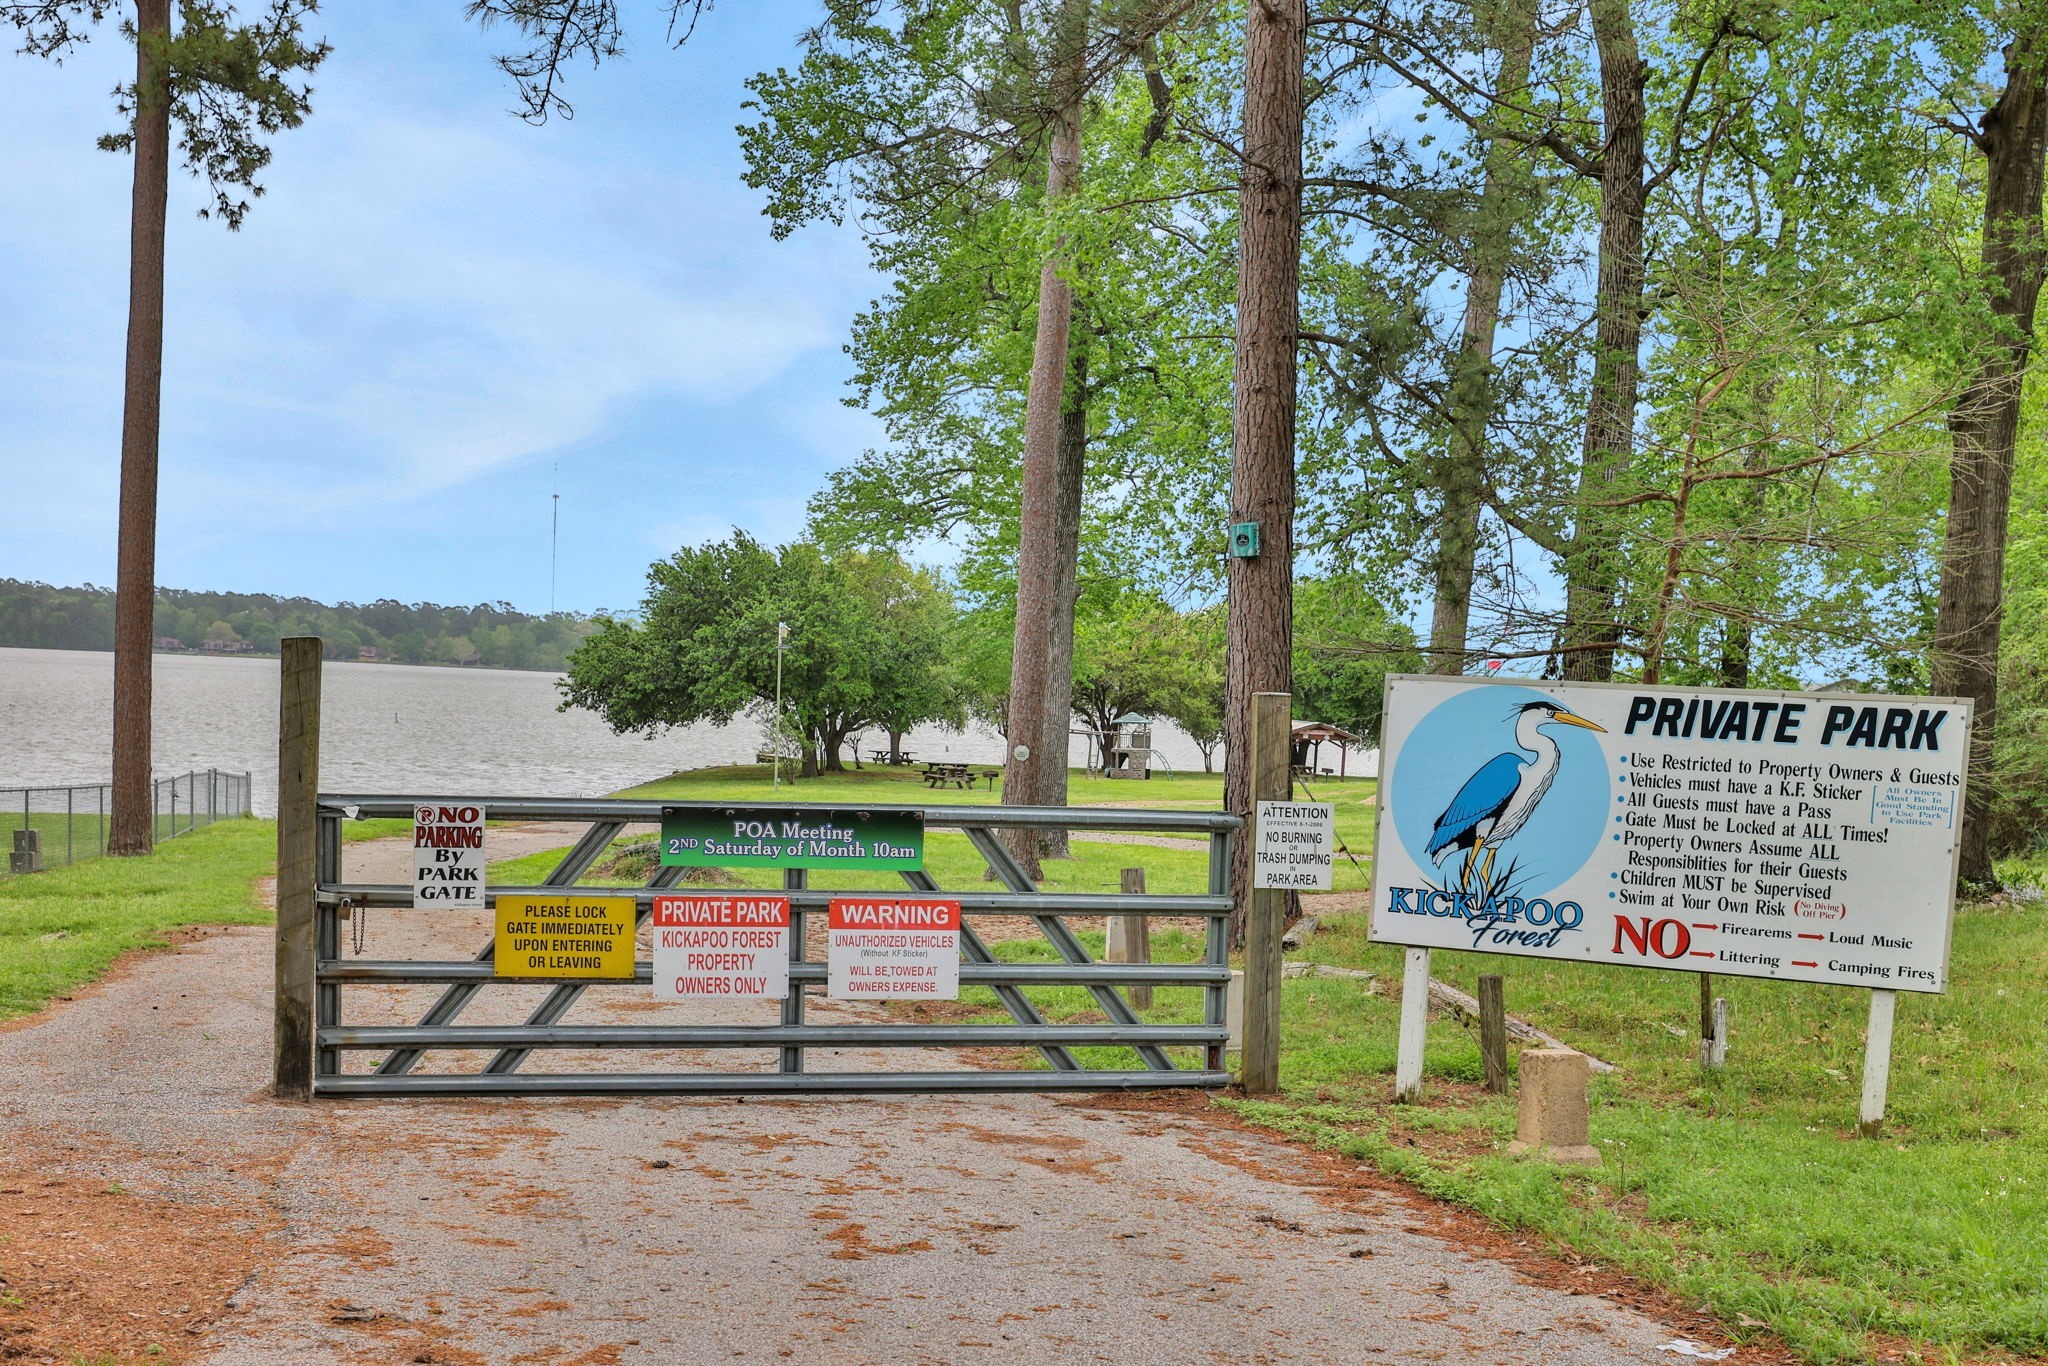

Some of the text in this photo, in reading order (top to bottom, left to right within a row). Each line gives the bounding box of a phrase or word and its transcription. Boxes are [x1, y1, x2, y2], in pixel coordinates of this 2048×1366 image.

[1624, 696, 1948, 751] PRIVATE PARK
[1631, 753, 1960, 786] Use Restricted to Property Owners & Guests
[1630, 772, 1862, 800] Vehicles must have a K.F. Sticker
[1905, 788, 1942, 796] Owners
[1263, 807, 1328, 818] ATTENTION
[1628, 792, 1831, 819] All Guests must have a Pass
[1906, 803, 1949, 813] Standing
[437, 807, 479, 823] NO
[1890, 817, 1933, 826] Facilities
[734, 822, 853, 842] POA Meeting
[1626, 811, 1888, 843] Gate Must be Locked at ALL Times!
[415, 826, 483, 848] PARKING
[1266, 832, 1322, 844] NO BURNING
[1624, 830, 1840, 860] Property Owners Assume ALL
[668, 838, 916, 859] 2ND Saturday of Month 10am
[436, 849, 464, 868] By
[1257, 852, 1330, 865] TRASH DUMPING
[1628, 850, 1848, 881] Responsiblities for their Guests
[418, 868, 478, 880] PARK
[1267, 873, 1317, 885] PARK AREA
[420, 886, 476, 899] GATE
[1621, 869, 1831, 900] Children MUST be Supervised
[1388, 886, 1584, 929] KICKAPOO
[1620, 889, 1786, 916] Swim at Your Own Risk
[1815, 902, 1840, 912] Diving
[525, 905, 607, 918] PLEASE LOCK
[661, 901, 783, 924] PRIVATE PARK
[841, 905, 949, 924] WARNING
[1803, 910, 1836, 919] Off Pier
[507, 922, 624, 935] GATE IMMEDIATELY
[1466, 912, 1583, 948] Forest
[1611, 915, 1690, 959] NO
[1722, 923, 1792, 940] Firearems
[514, 939, 612, 952] UPON ENTERING
[662, 931, 781, 948] KICKAPOO FOREST
[835, 935, 954, 948] UNAUTHORIZED VEHICLES
[1829, 932, 1913, 950] Loud Music
[528, 956, 601, 969] OR LEAVING
[688, 954, 755, 971] PROPERTY
[860, 949, 928, 959] (Without KF Sticker)
[1719, 950, 1780, 968] Littering
[850, 965, 937, 977] WILL BE TOWED AT
[1828, 960, 1935, 980] Camping Fires
[676, 977, 767, 994] OWNERS ONLY
[849, 981, 938, 992] OWNERS EXPENSE.
